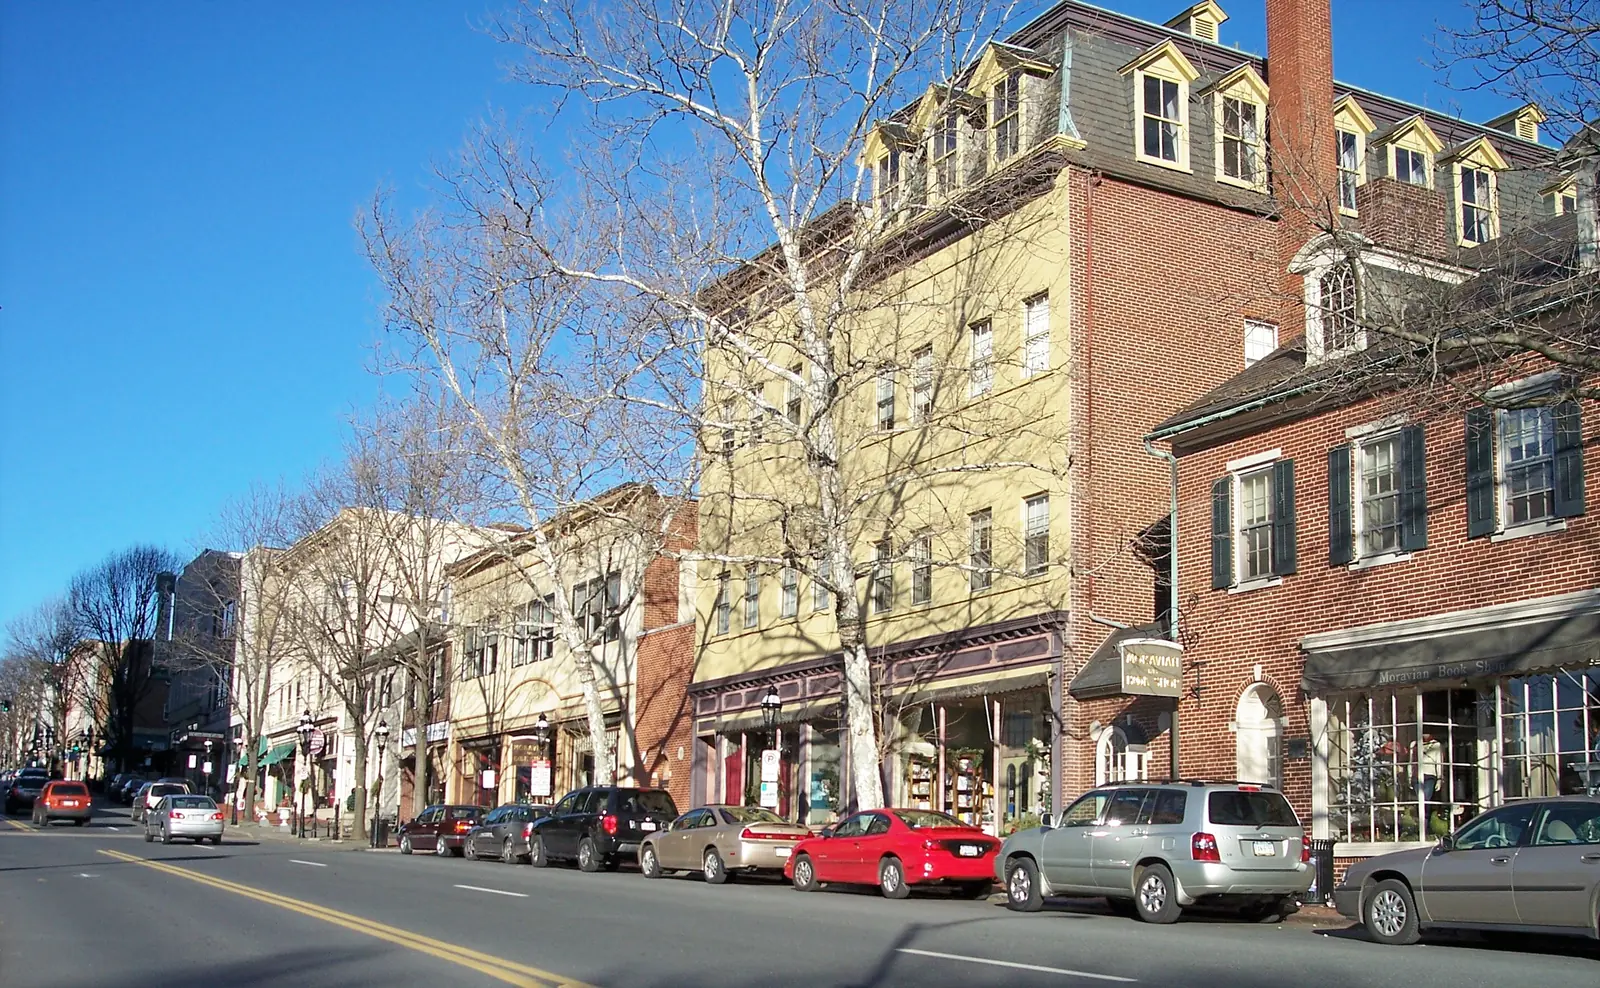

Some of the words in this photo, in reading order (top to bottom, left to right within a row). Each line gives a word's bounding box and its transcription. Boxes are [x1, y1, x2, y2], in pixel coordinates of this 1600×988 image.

[1379, 669, 1430, 683] Moravian
[1438, 664, 1468, 677] Book
[1475, 660, 1506, 675] Shop
